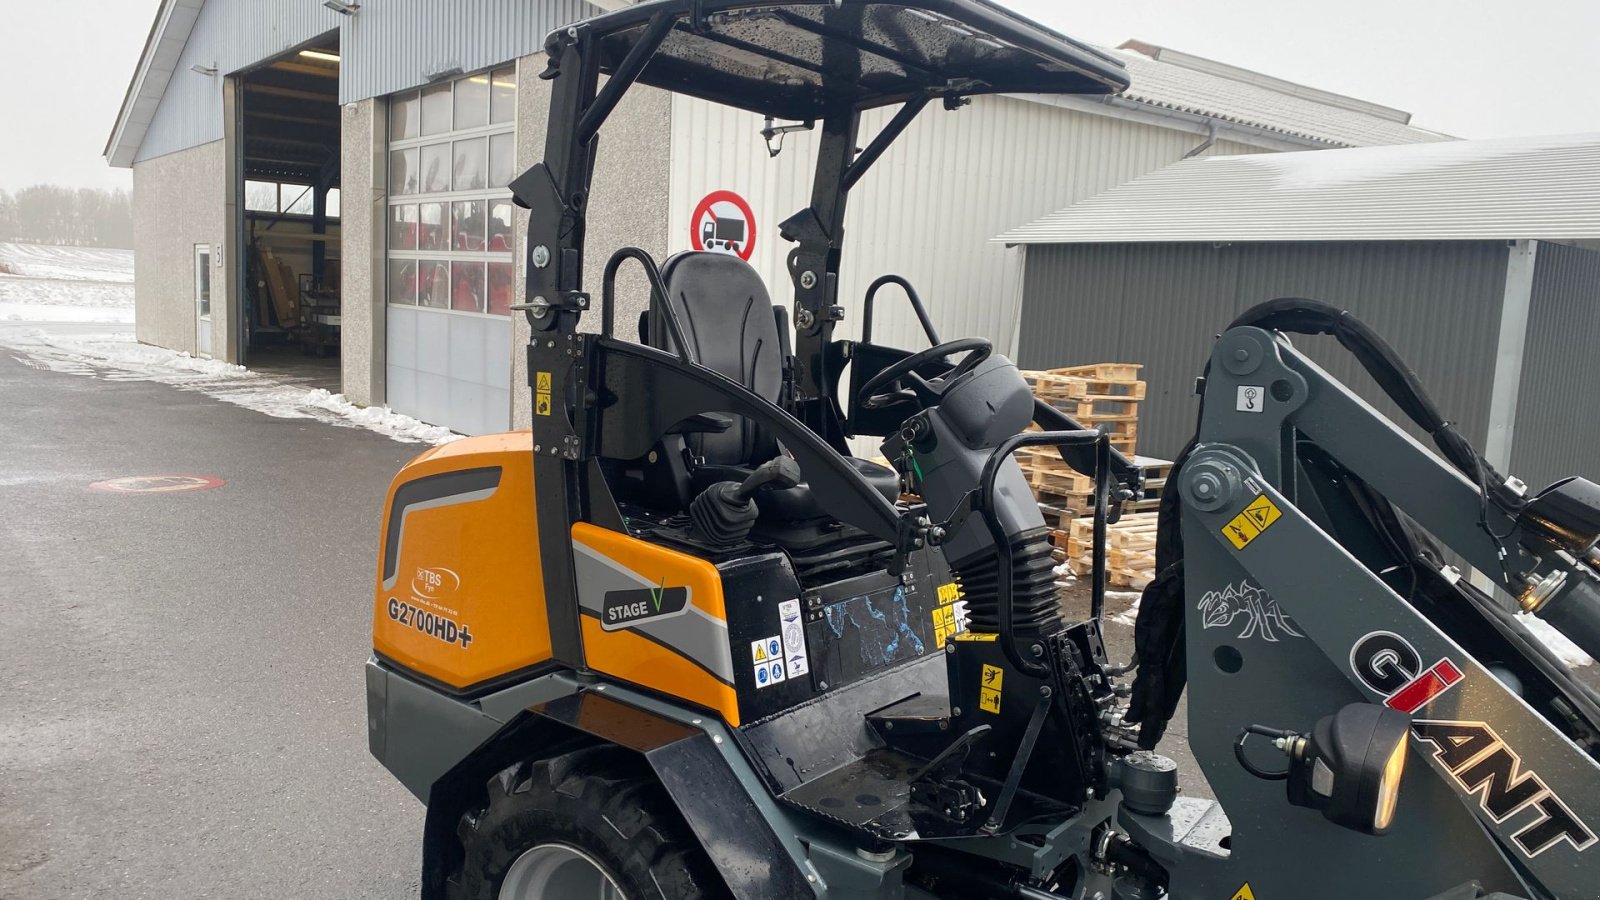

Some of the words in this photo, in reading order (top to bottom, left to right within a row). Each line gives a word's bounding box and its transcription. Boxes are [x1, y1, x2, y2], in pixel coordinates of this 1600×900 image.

[424, 569, 441, 586] TBS
[608, 601, 648, 621] STAGE
[650, 576, 665, 613] V
[387, 597, 473, 649] G2700HD+
